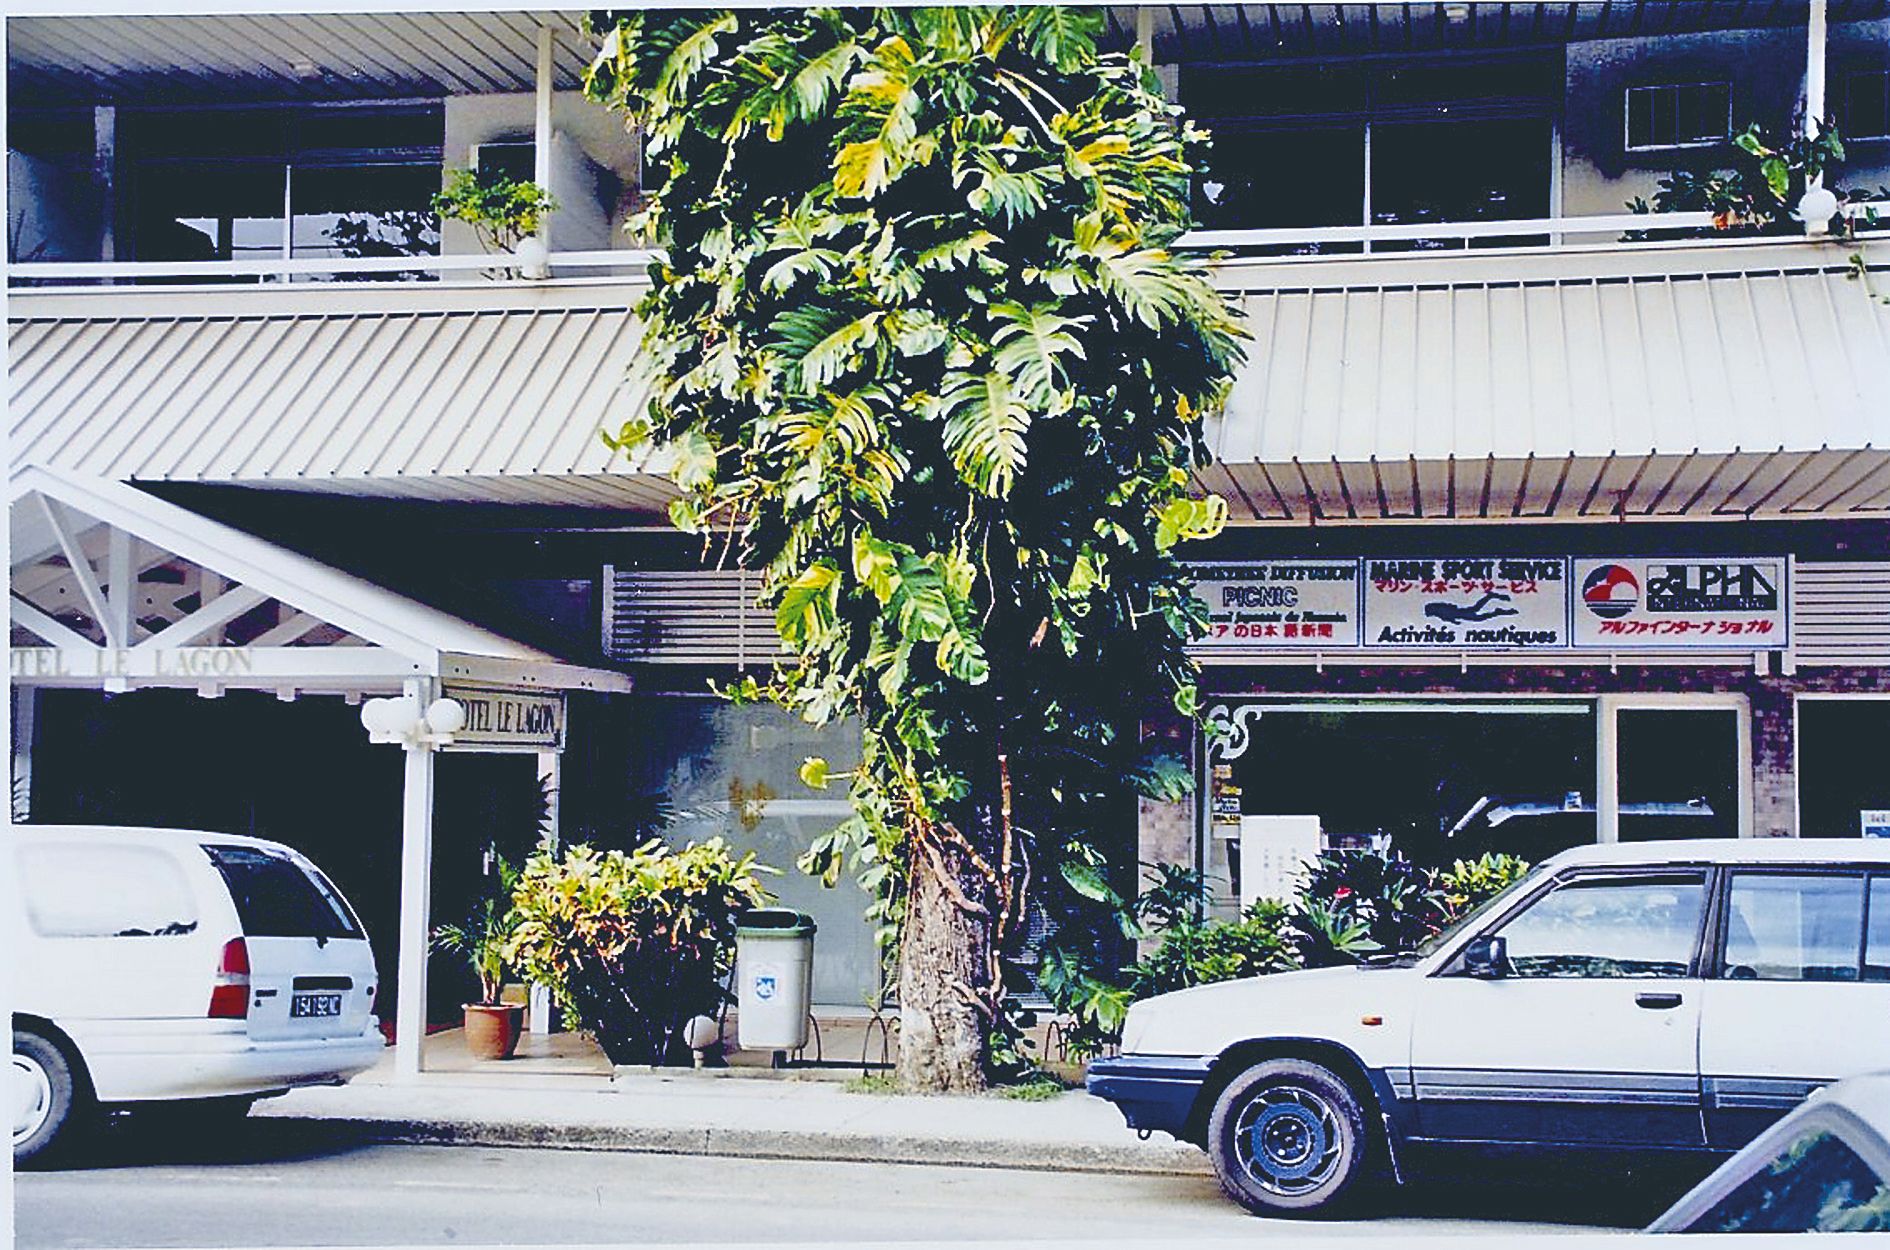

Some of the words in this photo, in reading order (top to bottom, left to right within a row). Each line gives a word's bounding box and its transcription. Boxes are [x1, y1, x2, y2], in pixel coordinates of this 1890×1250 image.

[1370, 561, 1435, 580] MARINE
[1441, 561, 1494, 580] SPORT
[1498, 561, 1562, 580] SERVICE
[1222, 586, 1298, 607] PICNIC
[1378, 626, 1456, 642] Activités
[1464, 625, 1557, 645] nautiques
[10, 649, 70, 676] TEL
[96, 649, 130, 675] LE
[155, 648, 255, 676] LAGON
[497, 701, 512, 732] LE
[516, 702, 555, 734] LAGON
